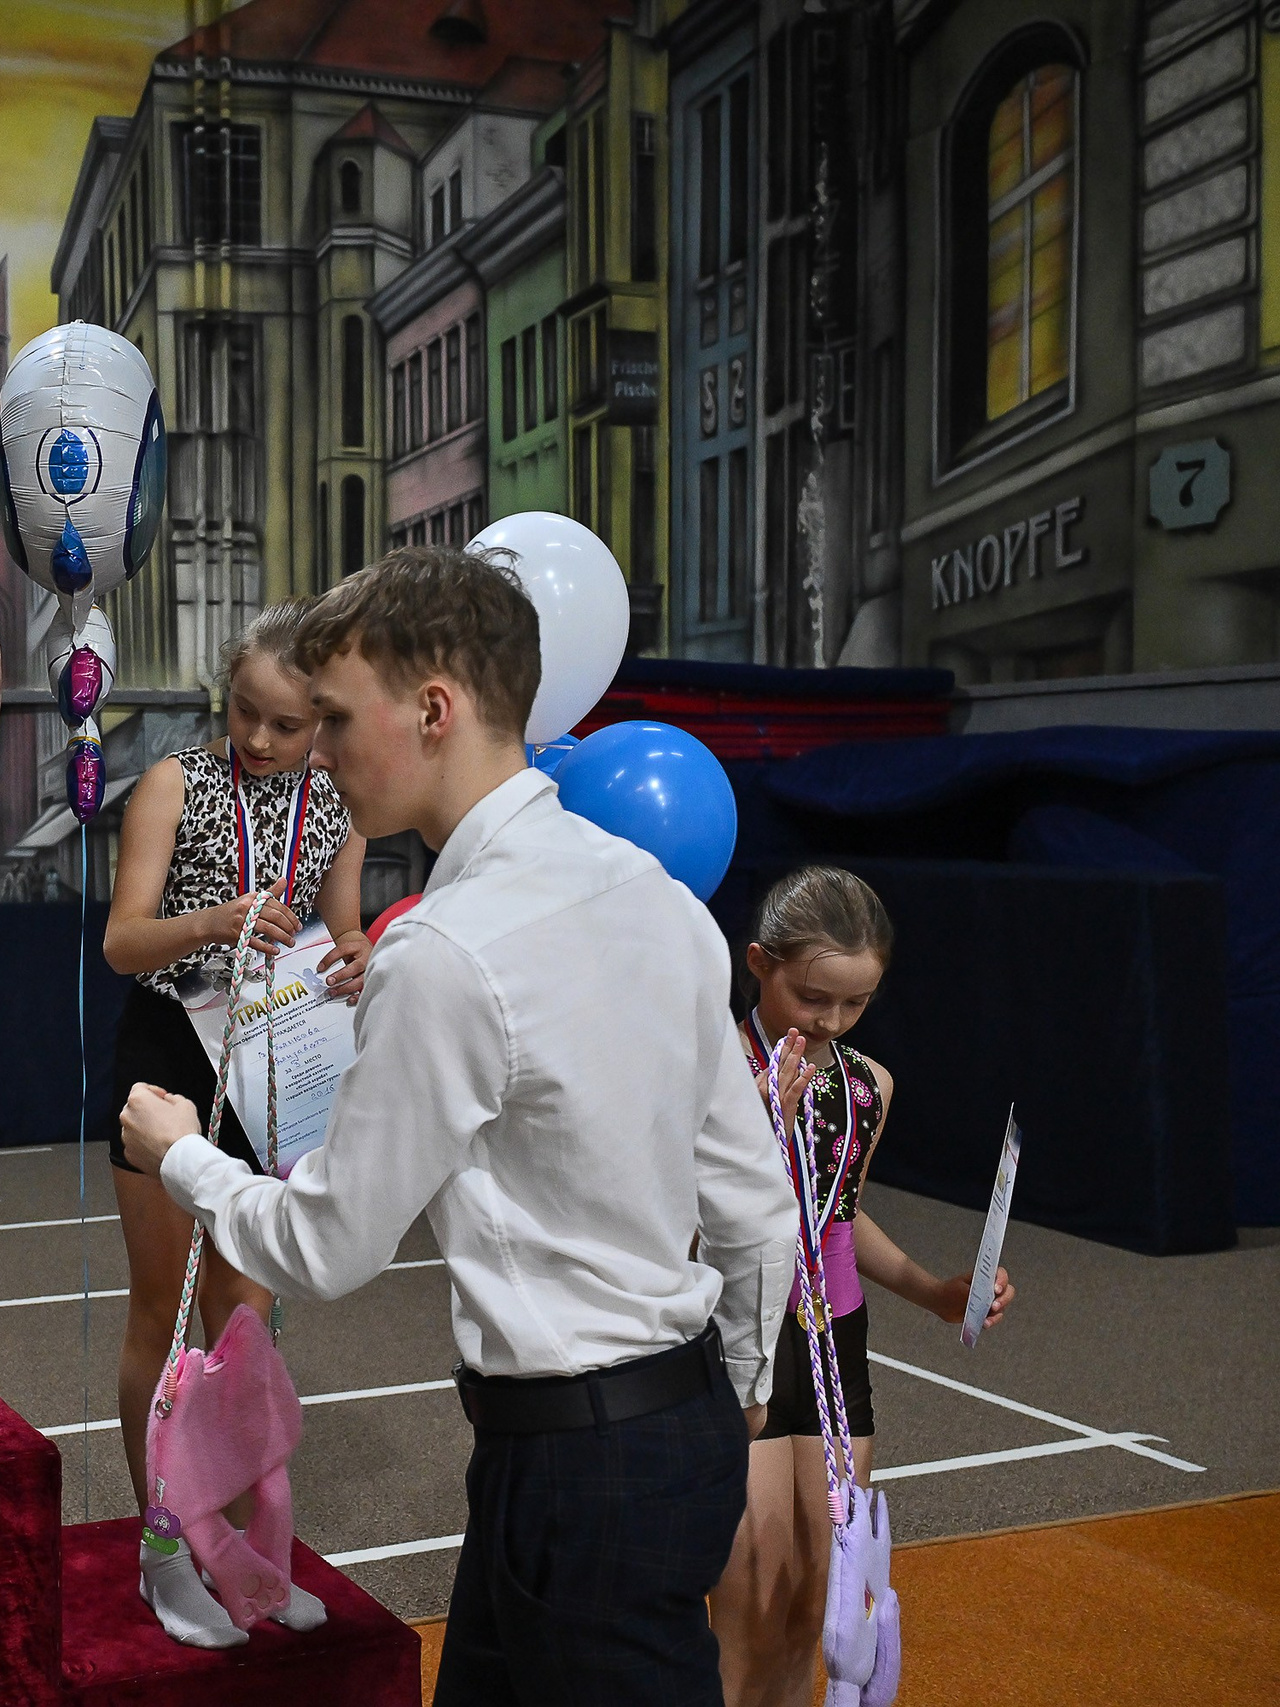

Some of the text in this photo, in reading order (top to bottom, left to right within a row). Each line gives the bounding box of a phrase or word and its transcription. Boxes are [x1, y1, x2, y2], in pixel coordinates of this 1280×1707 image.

[1175, 458, 1206, 509] 7
[931, 497, 1083, 610] KNOPFE
[272, 1019, 307, 1039] АГРАЖДАЕТСЯ
[304, 1053, 322, 1065] место
